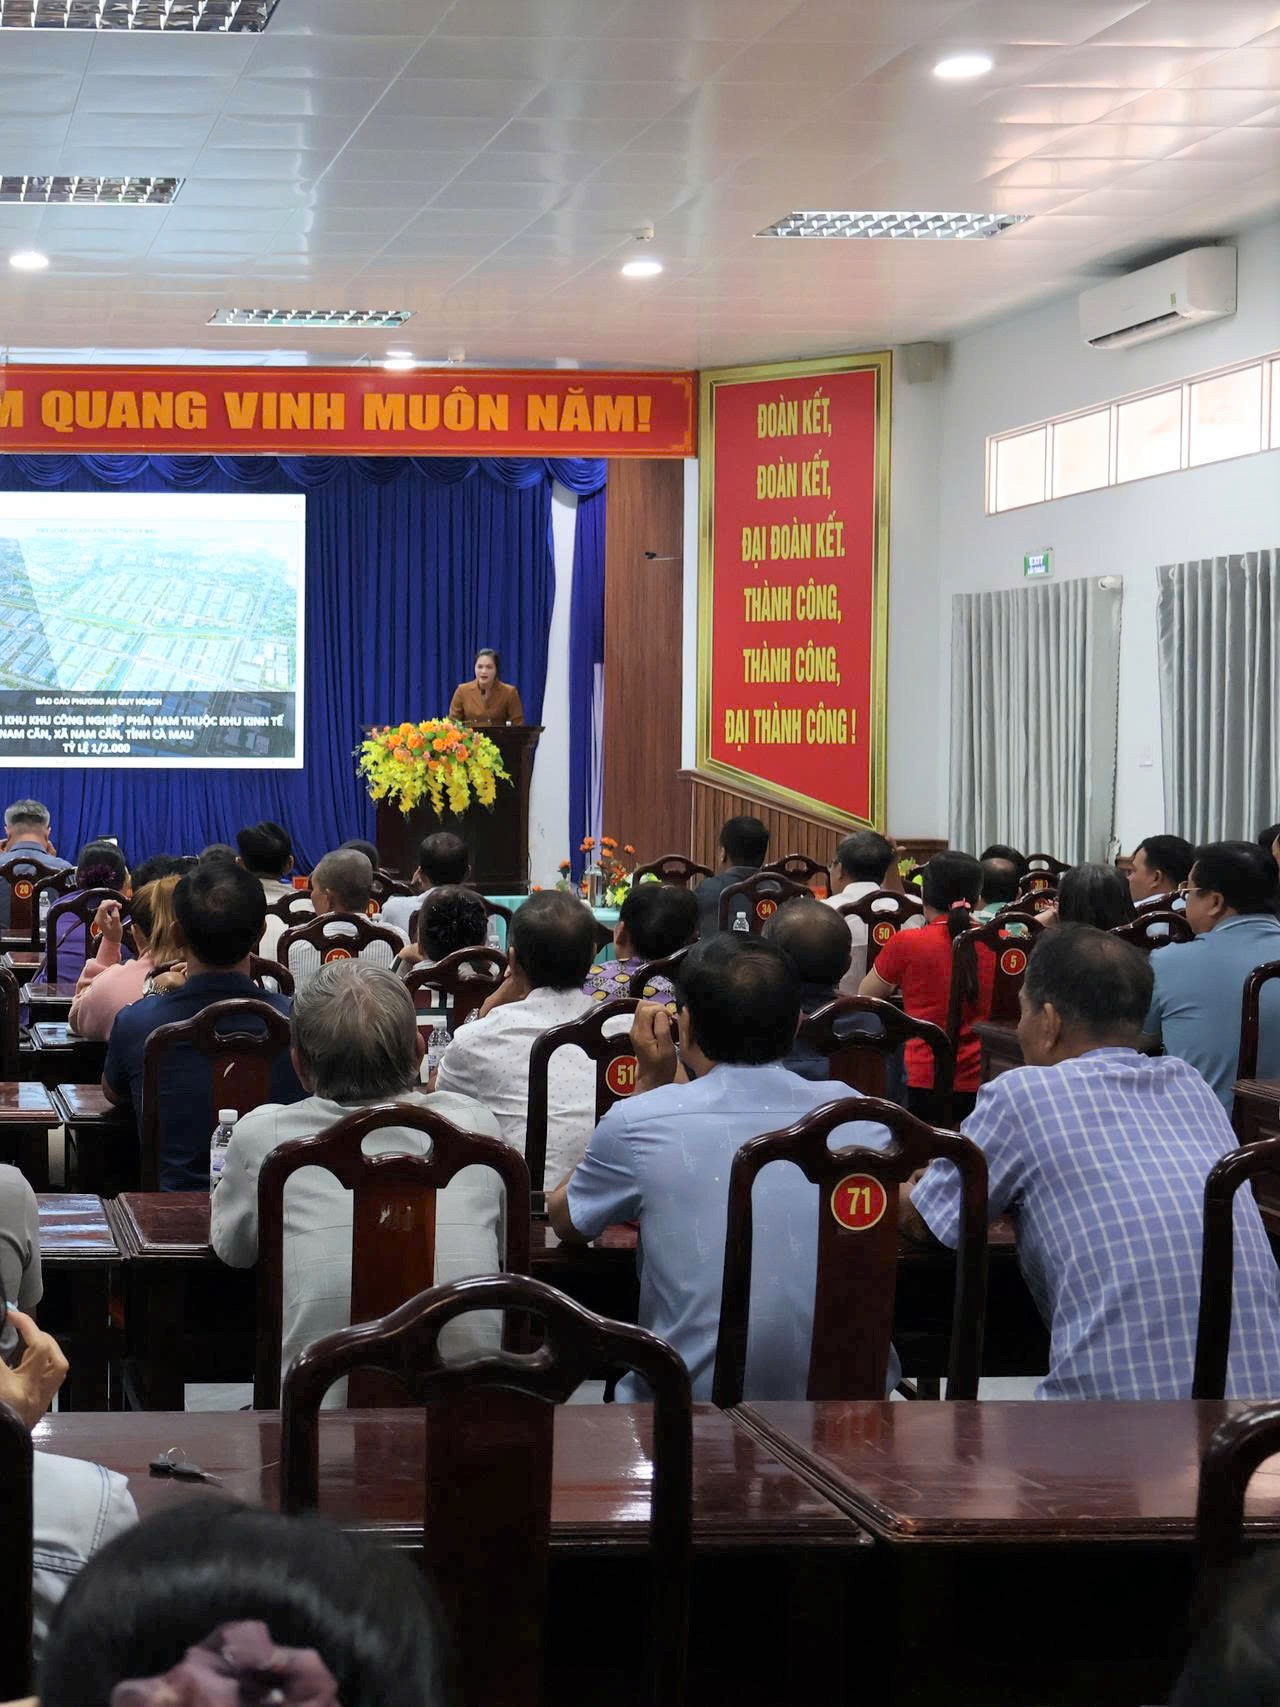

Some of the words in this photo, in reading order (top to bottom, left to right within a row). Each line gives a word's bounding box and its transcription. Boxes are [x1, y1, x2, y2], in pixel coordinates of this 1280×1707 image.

[41, 390, 207, 432] QUANG
[224, 392, 345, 430] VINH
[363, 385, 509, 432] MUÔN
[527, 387, 652, 432] NĂM!
[757, 394, 798, 438] ĐOÀN
[802, 387, 832, 437] KẾT,
[756, 456, 798, 500] ĐOÀN
[802, 449, 832, 499] KẾT,
[741, 526, 767, 568] ĐẠI
[770, 517, 811, 560] ĐOÀN
[743, 580, 792, 622] THÀNH
[796, 578, 842, 624] CÔNG,
[743, 640, 791, 683] THÀNH
[795, 640, 841, 687] CÔNG,
[0, 729, 25, 740] NAM
[70, 729, 96, 740] NAM
[168, 729, 194, 740] MAU
[4, 715, 27, 725] KHU
[29, 715, 51, 725] KHU
[53, 713, 83, 726] CÔNG
[153, 715, 180, 726] NAM
[219, 716, 241, 726] KHU
[243, 716, 269, 727] KINH
[725, 709, 750, 752] ĐẠI
[753, 701, 802, 744] THÀNH
[806, 701, 848, 744] CÔNG
[878, 929, 890, 940] 50
[1010, 955, 1017, 968] 5
[616, 1064, 634, 1085] 51
[848, 1188, 872, 1214] 71
